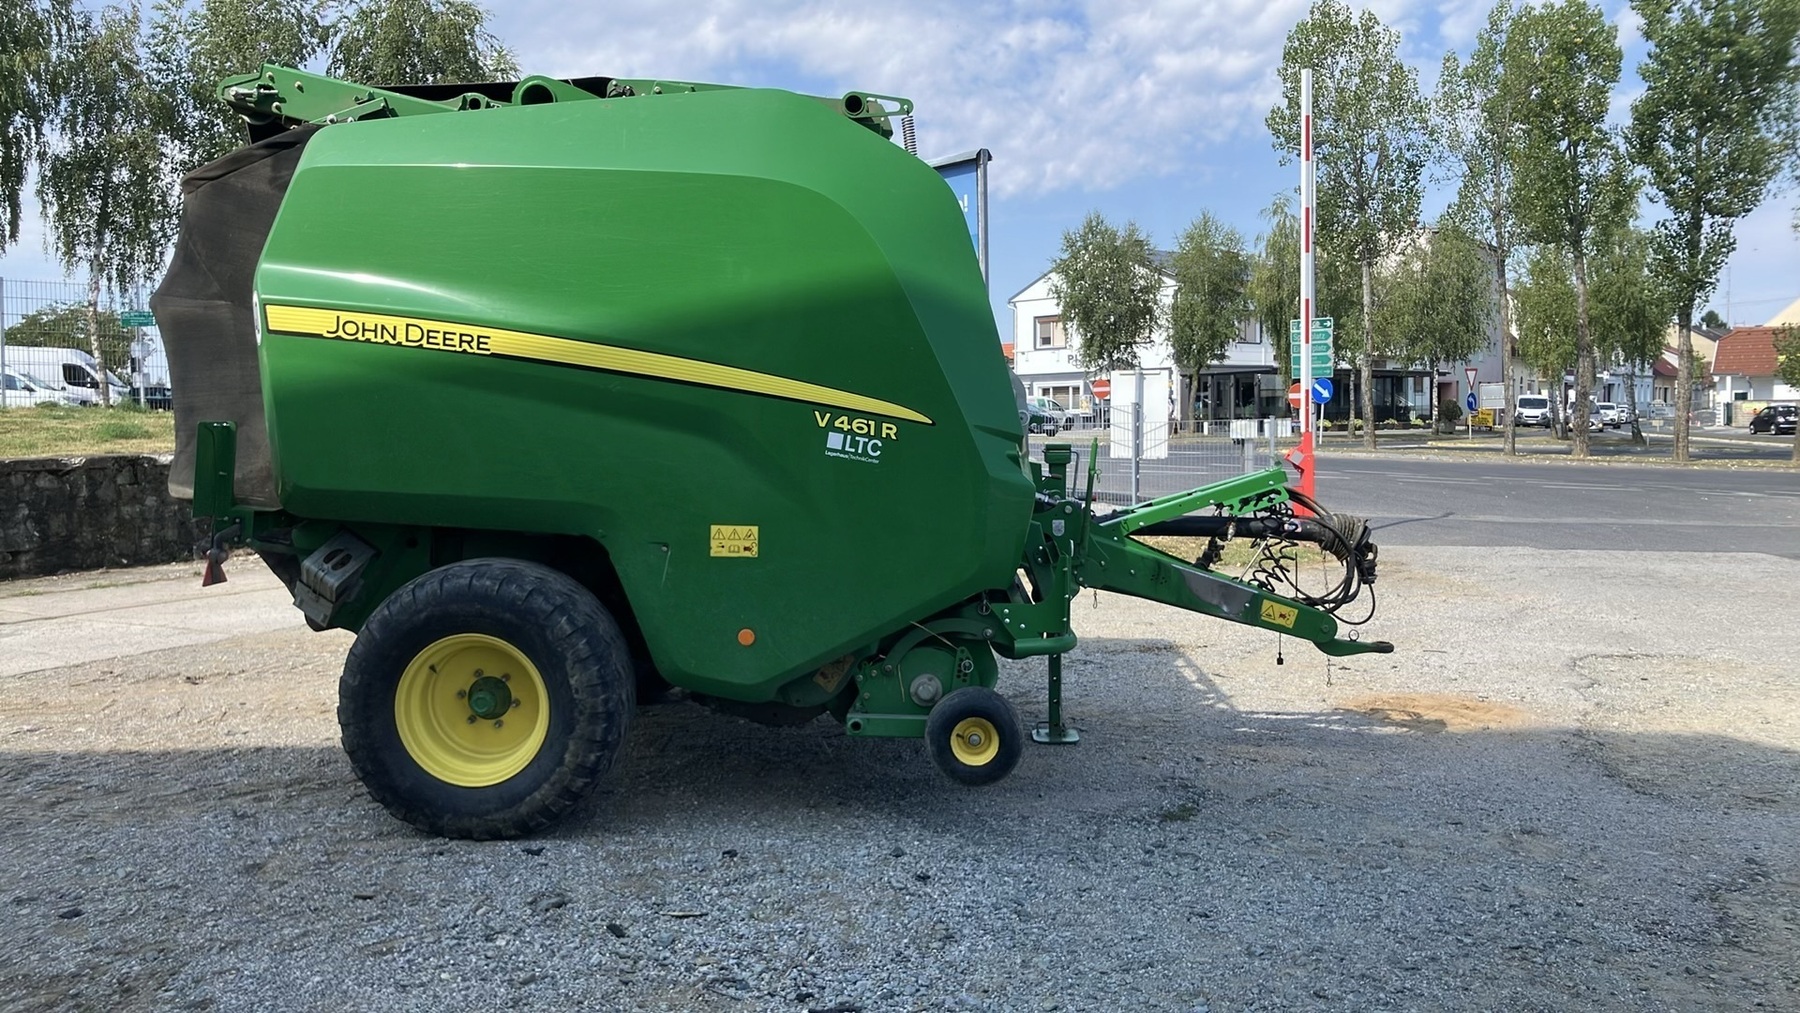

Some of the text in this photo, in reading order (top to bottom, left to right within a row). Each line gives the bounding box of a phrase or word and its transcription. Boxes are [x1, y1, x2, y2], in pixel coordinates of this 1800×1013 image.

[325, 315, 492, 352] JOHN DEERE
[814, 410, 897, 440] V 461 R
[844, 434, 883, 457] LTC
